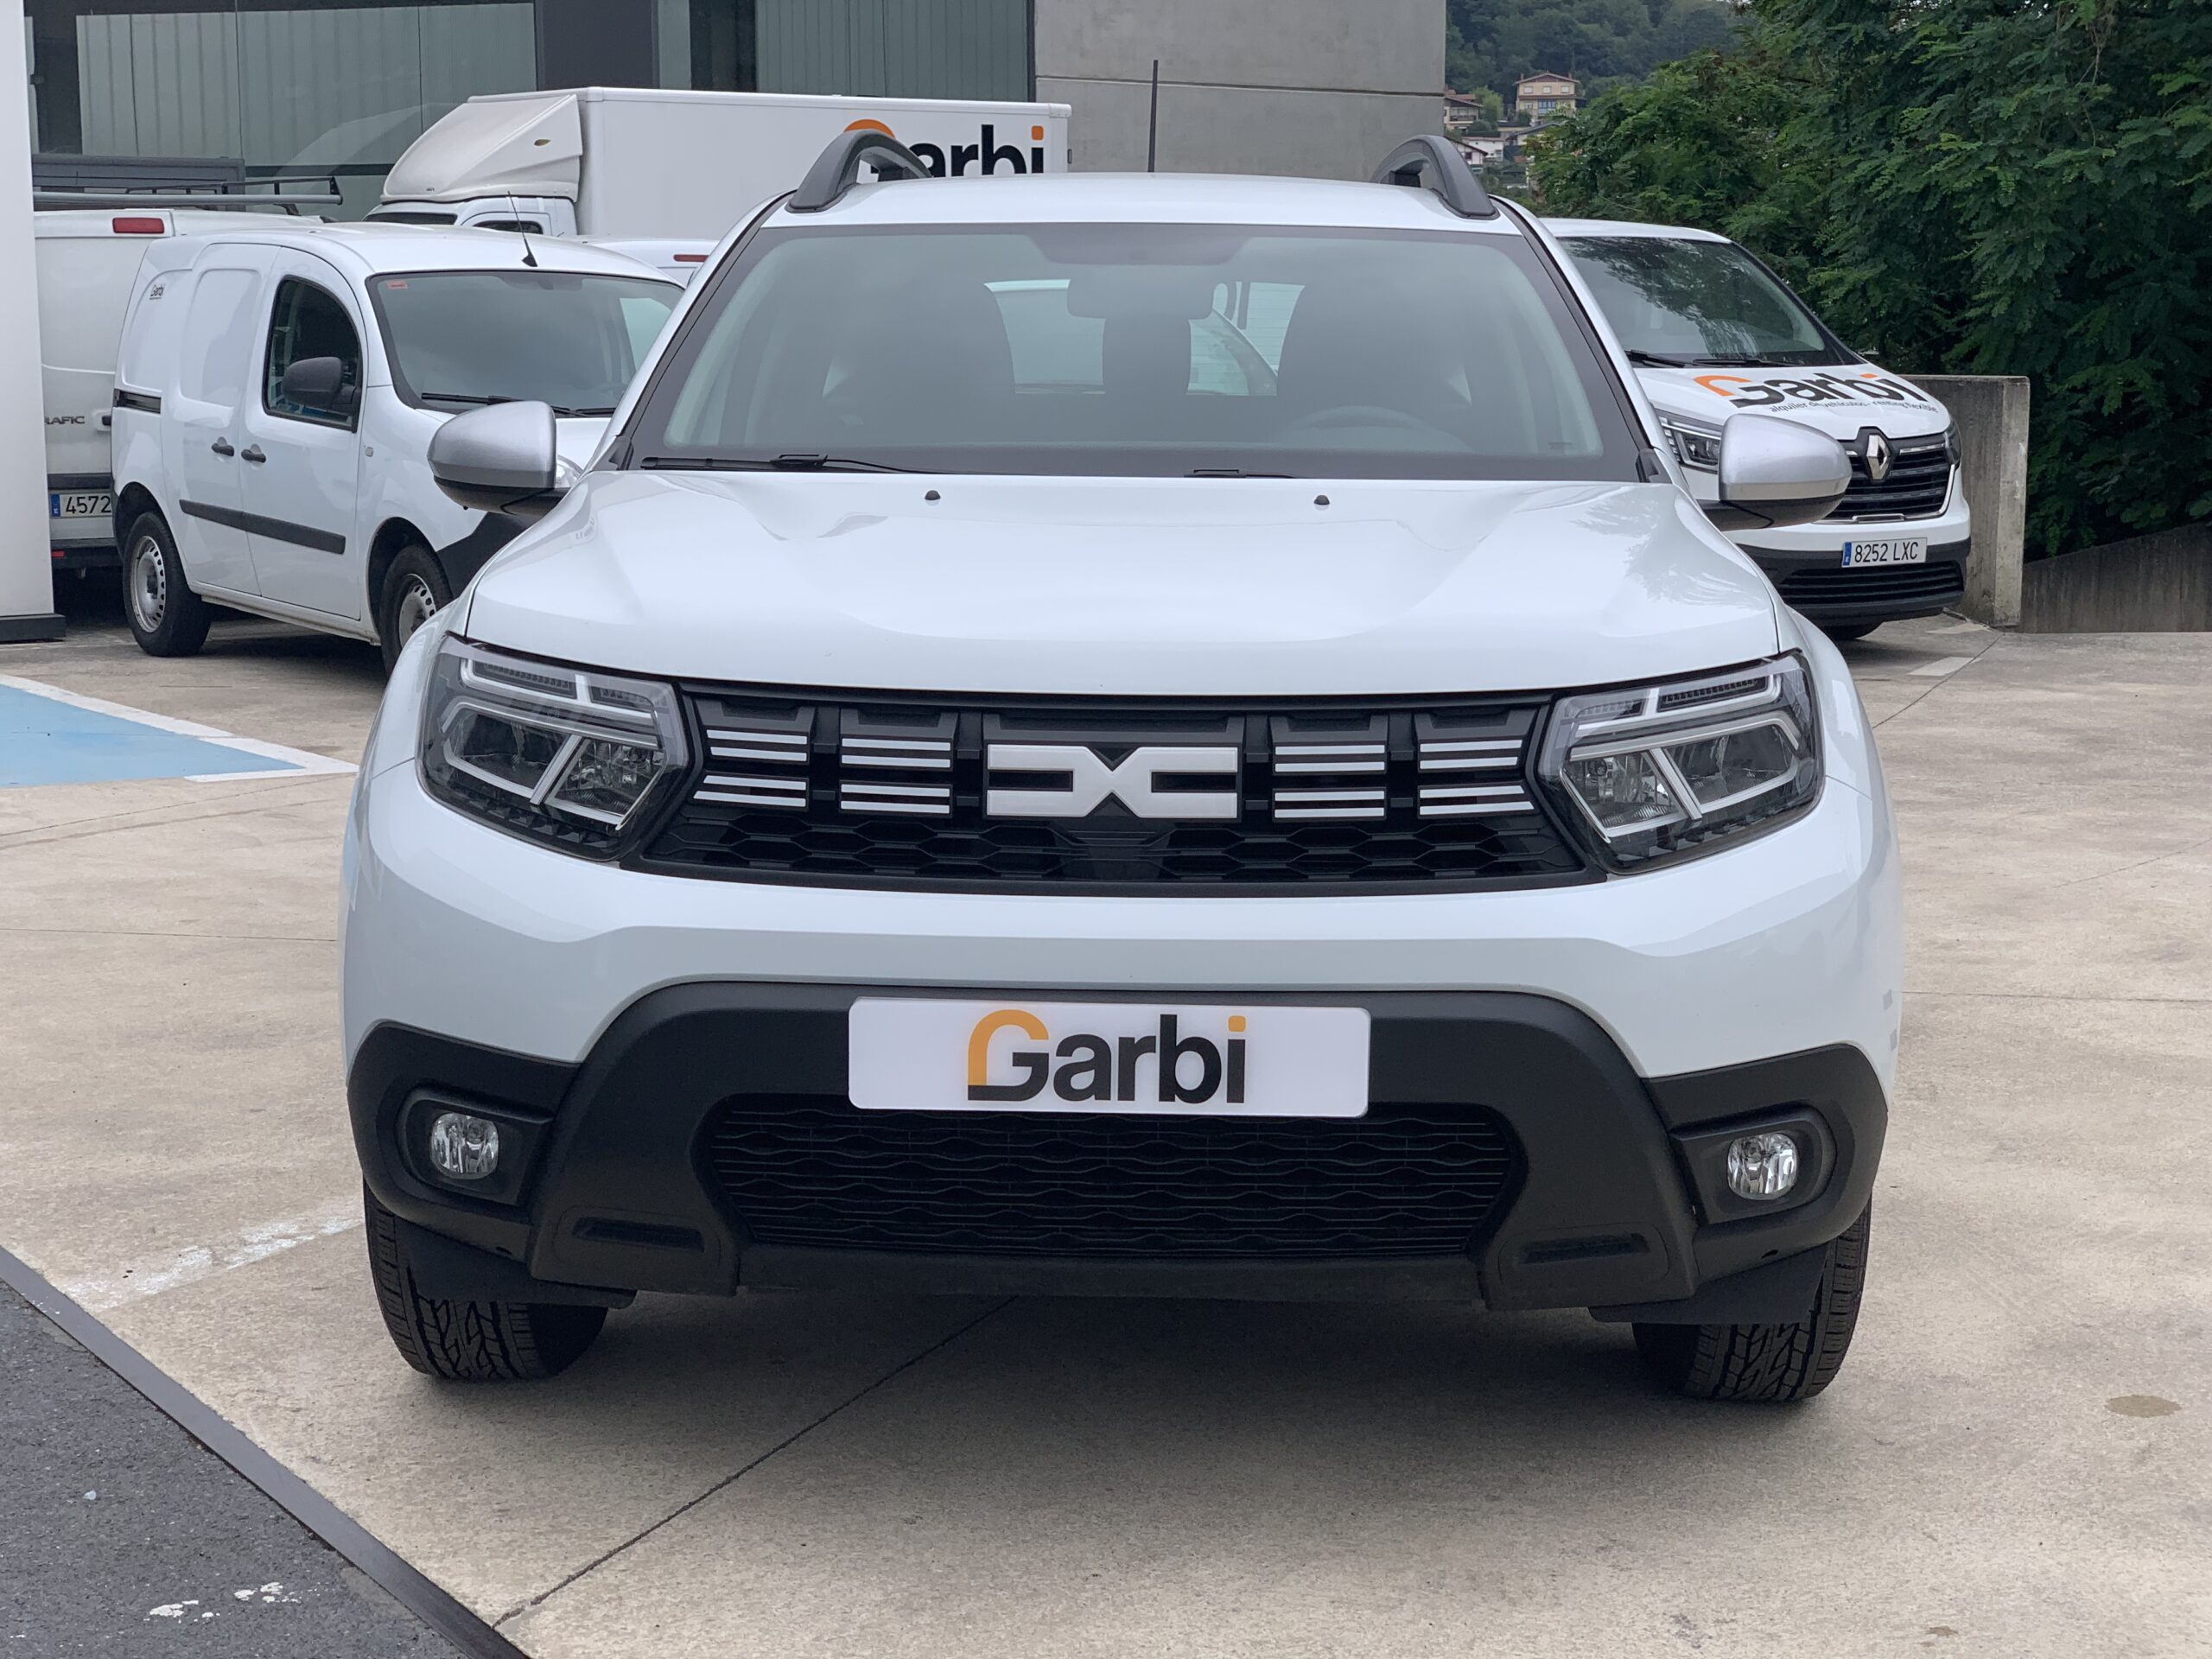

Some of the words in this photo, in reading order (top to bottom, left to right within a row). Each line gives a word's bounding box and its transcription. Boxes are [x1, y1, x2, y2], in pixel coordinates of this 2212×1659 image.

[1693, 372, 1928, 409] Garbi
[66, 495, 111, 514] 4572
[1854, 543, 1889, 563] 8252
[1892, 541, 1919, 562] LXC
[968, 1008, 1246, 1104] Garbi
